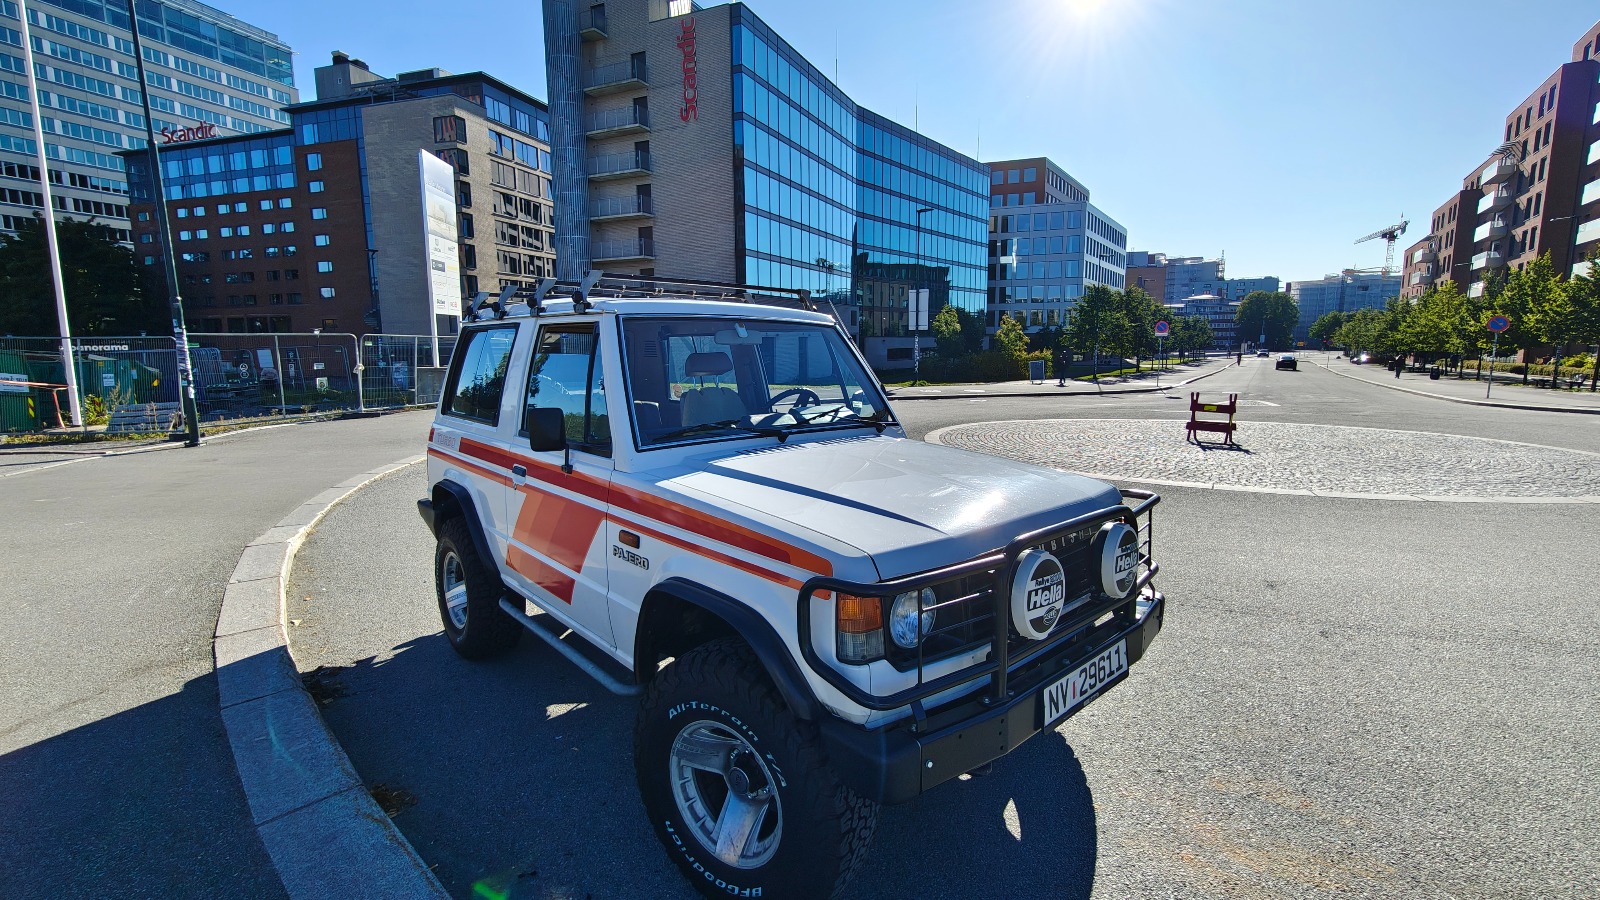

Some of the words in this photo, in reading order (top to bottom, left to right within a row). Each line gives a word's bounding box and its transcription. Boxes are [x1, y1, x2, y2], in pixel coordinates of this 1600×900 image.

[677, 16, 698, 122] Scandic
[161, 120, 217, 144] Scandic
[612, 544, 650, 570] PAJERO
[1116, 552, 1138, 573] Hella
[1029, 584, 1062, 610] Hella
[1048, 678, 1070, 719] NV
[1079, 645, 1124, 698] 29611
[668, 701, 760, 742] All-Terrain
[766, 751, 787, 787] T/A
[665, 820, 762, 898] BFGoodrich
